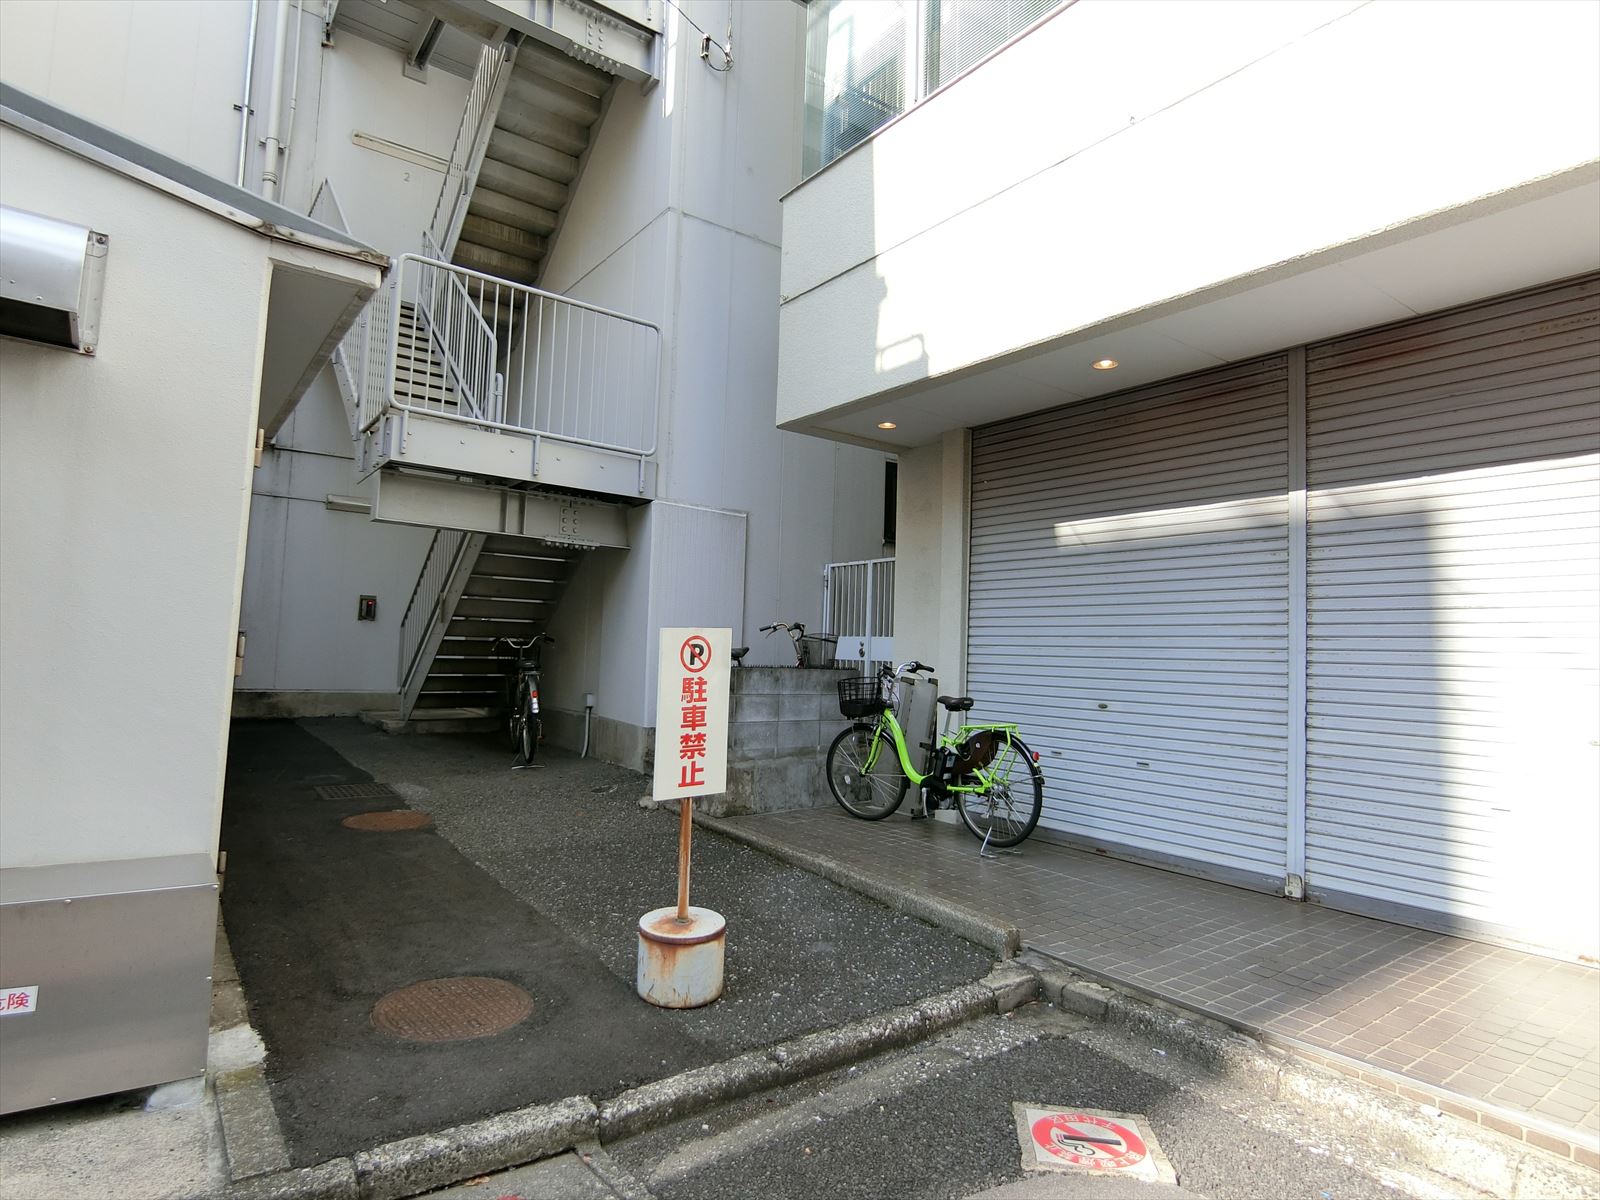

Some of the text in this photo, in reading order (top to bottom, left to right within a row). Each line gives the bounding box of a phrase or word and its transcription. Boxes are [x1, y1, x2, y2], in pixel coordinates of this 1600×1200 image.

[689, 643, 705, 666] P
[678, 676, 708, 788] 駐車禁止
